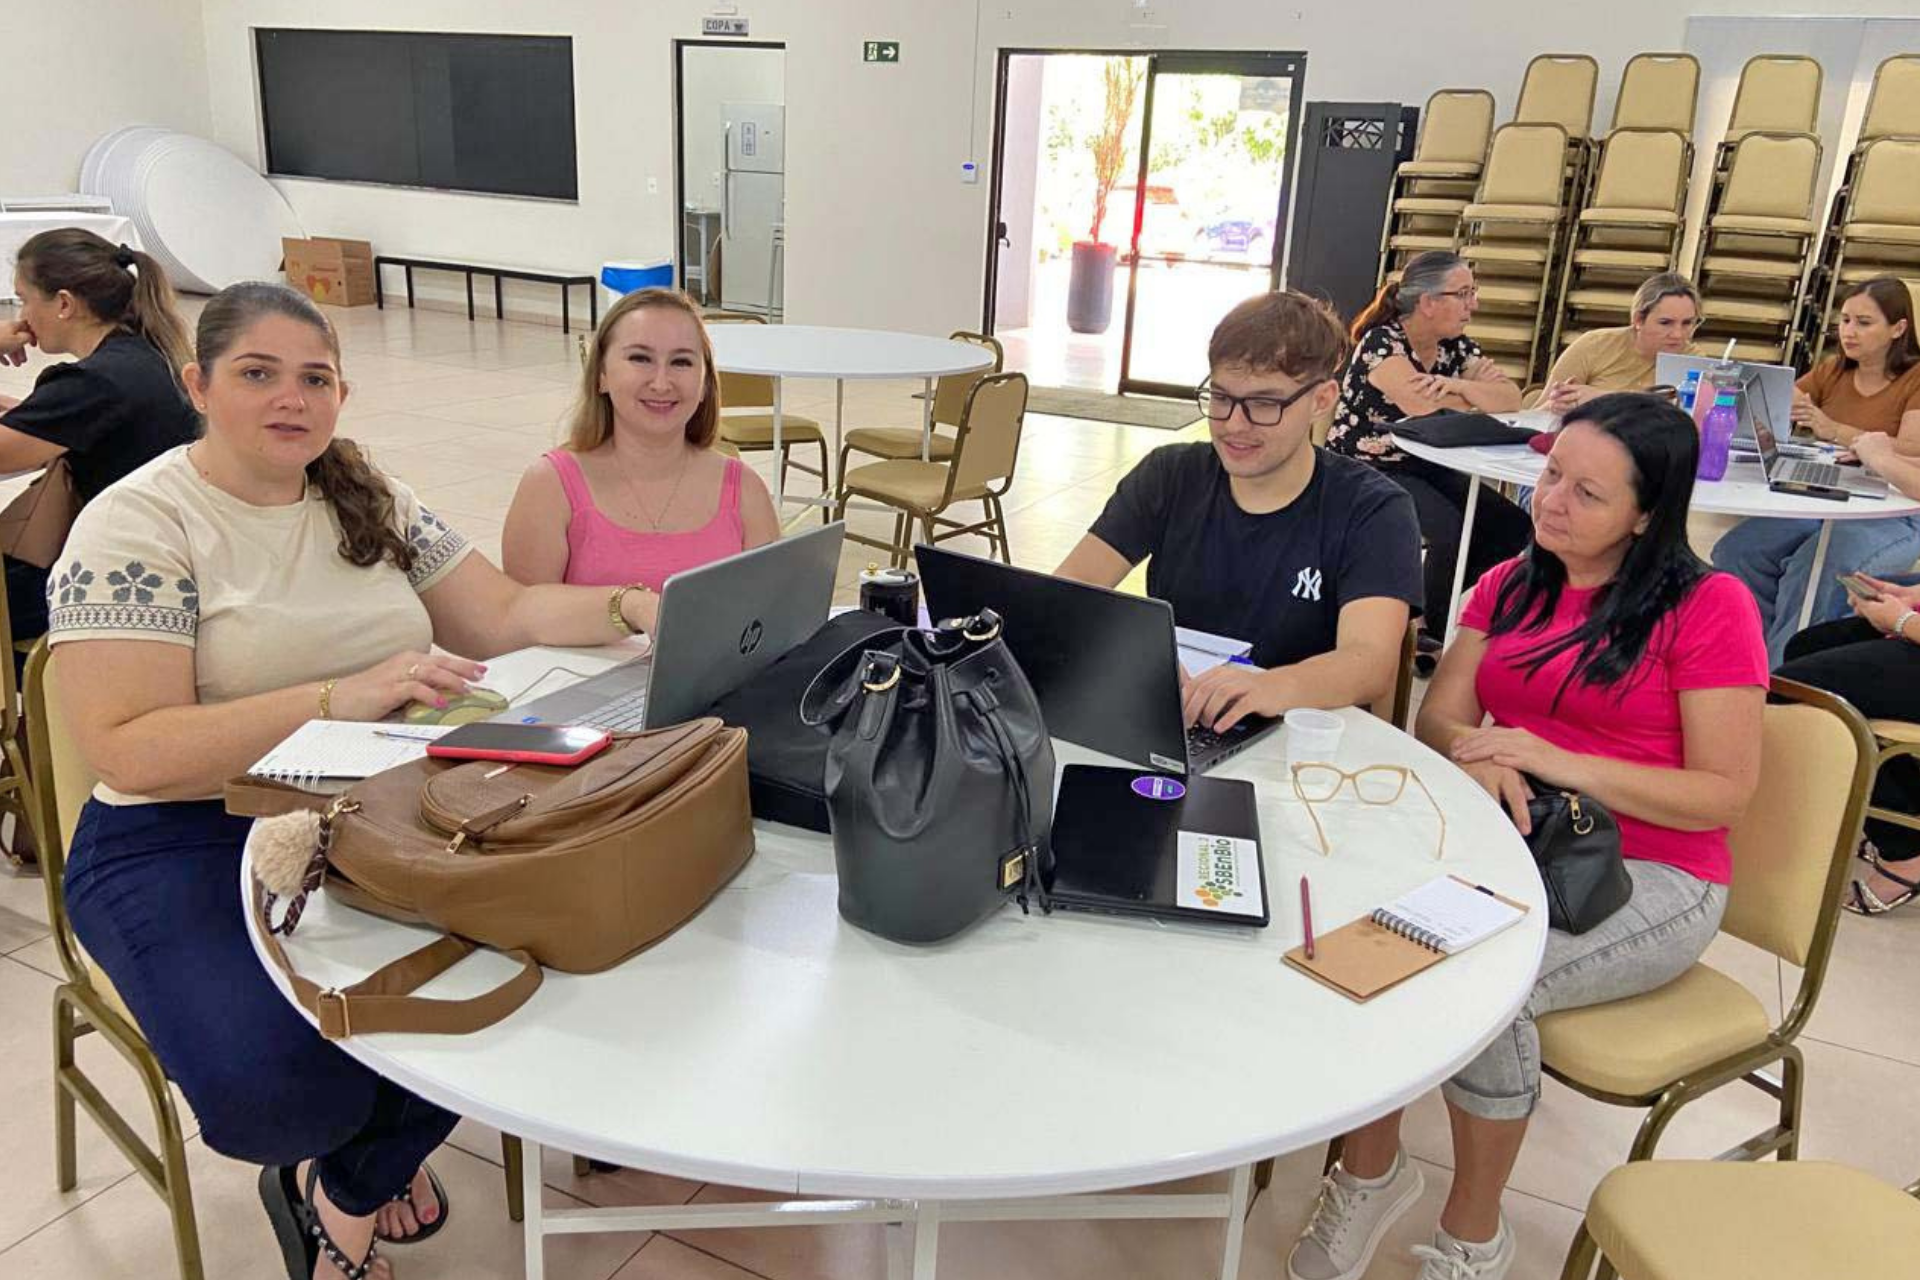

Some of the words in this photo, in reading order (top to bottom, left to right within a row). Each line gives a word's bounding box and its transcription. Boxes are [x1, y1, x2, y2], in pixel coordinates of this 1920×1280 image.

[705, 20, 730, 31] COPA
[1291, 566, 1323, 601] NY
[1212, 838, 1233, 886] SBEnBio
